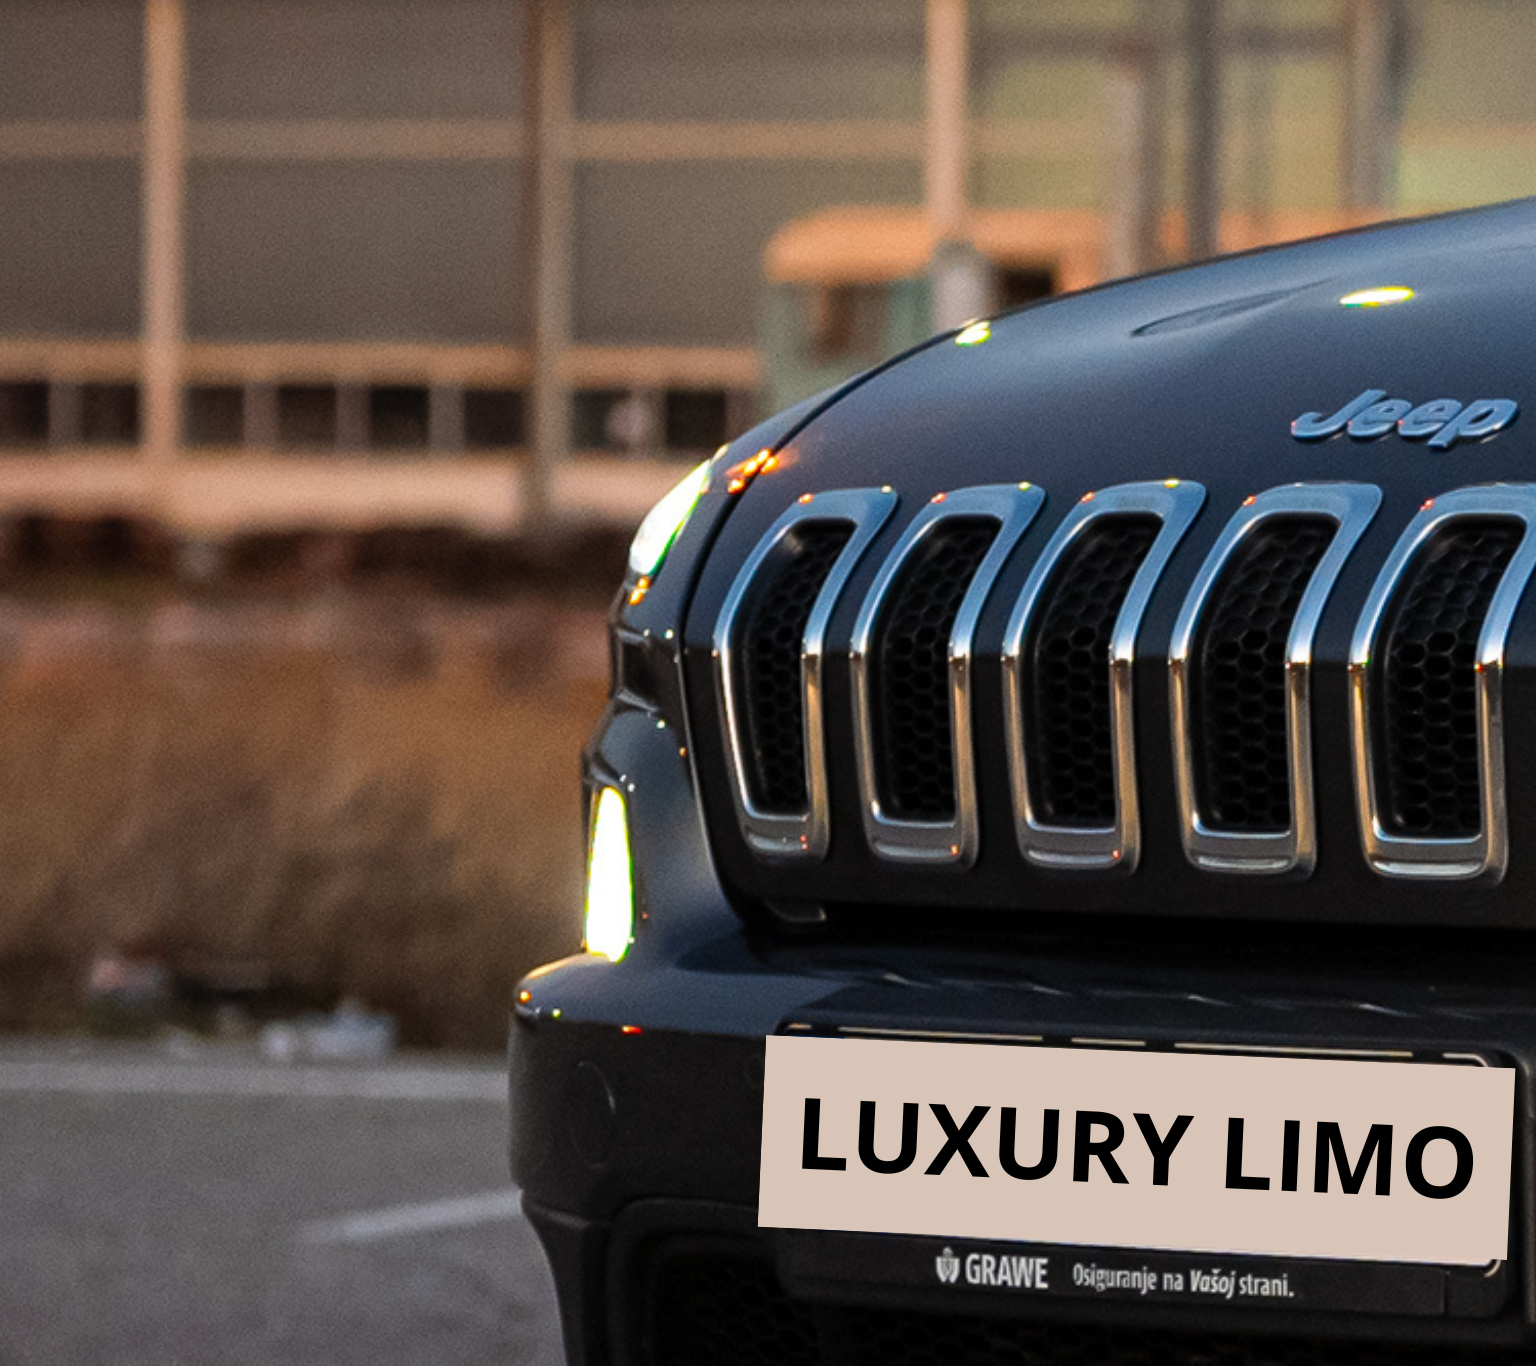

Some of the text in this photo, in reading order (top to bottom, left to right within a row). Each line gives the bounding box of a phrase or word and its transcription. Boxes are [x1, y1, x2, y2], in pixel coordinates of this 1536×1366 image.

[1291, 389, 1518, 448] Jeep
[802, 1098, 1473, 1199] LUXURY LIMO
[965, 1253, 1295, 1299] GRAWE Osiguranje na Vašoj strani.
